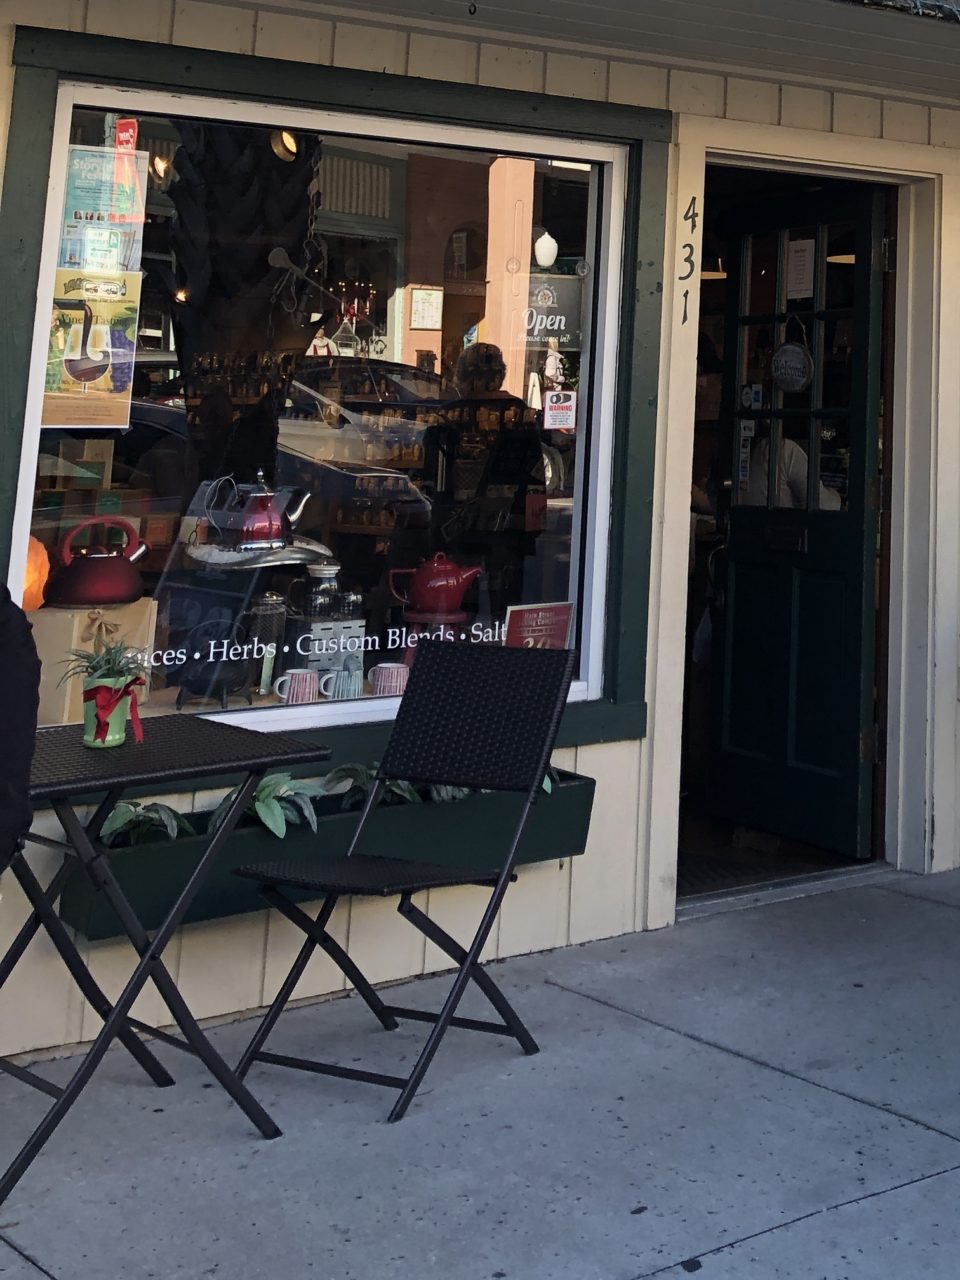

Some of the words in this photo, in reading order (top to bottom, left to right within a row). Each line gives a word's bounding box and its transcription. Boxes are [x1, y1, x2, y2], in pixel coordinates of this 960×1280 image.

[521, 307, 567, 336] Open
[548, 404, 573, 412] WARNING
[207, 636, 277, 662] Herbs
[295, 632, 380, 657] Custom
